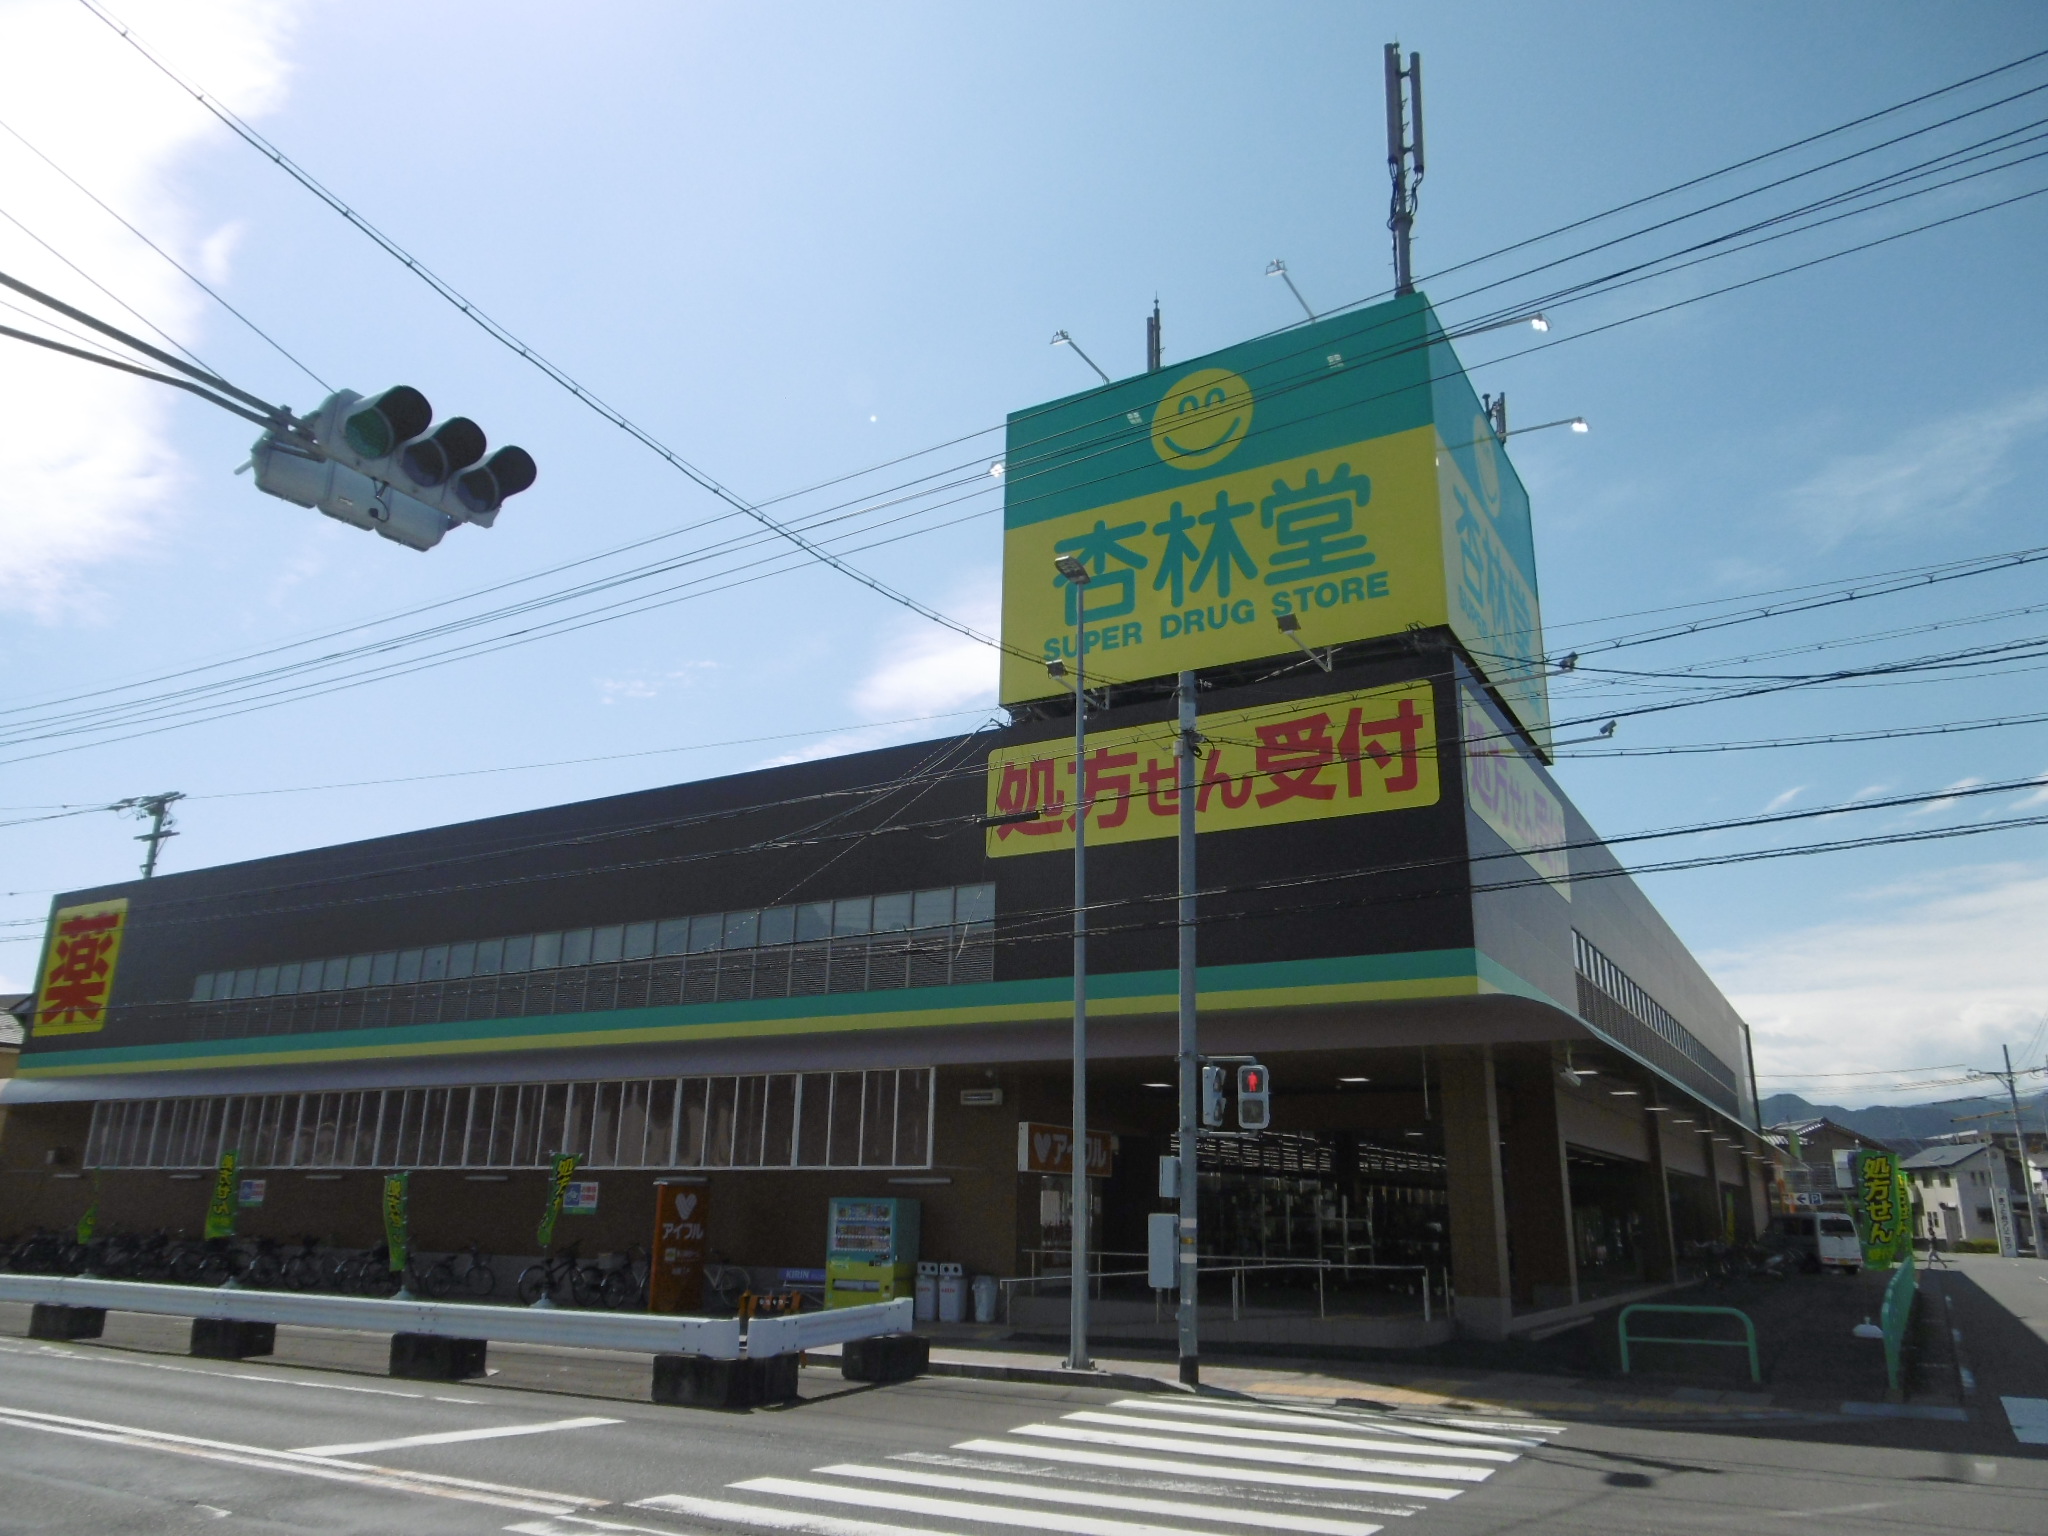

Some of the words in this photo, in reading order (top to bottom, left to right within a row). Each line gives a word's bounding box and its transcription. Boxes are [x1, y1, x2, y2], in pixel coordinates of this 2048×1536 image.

[1052, 462, 1376, 627] 杏林堂
[1043, 620, 1142, 661] SUPER
[1160, 601, 1255, 640] DRUG
[1271, 571, 1390, 617] STORE
[996, 699, 1424, 840] 処方せん受付
[41, 913, 119, 1024] 薬
[662, 1222, 703, 1240] アイフル
[1863, 1156, 1893, 1244] 処方せん
[786, 1269, 810, 1279] KIRIN
